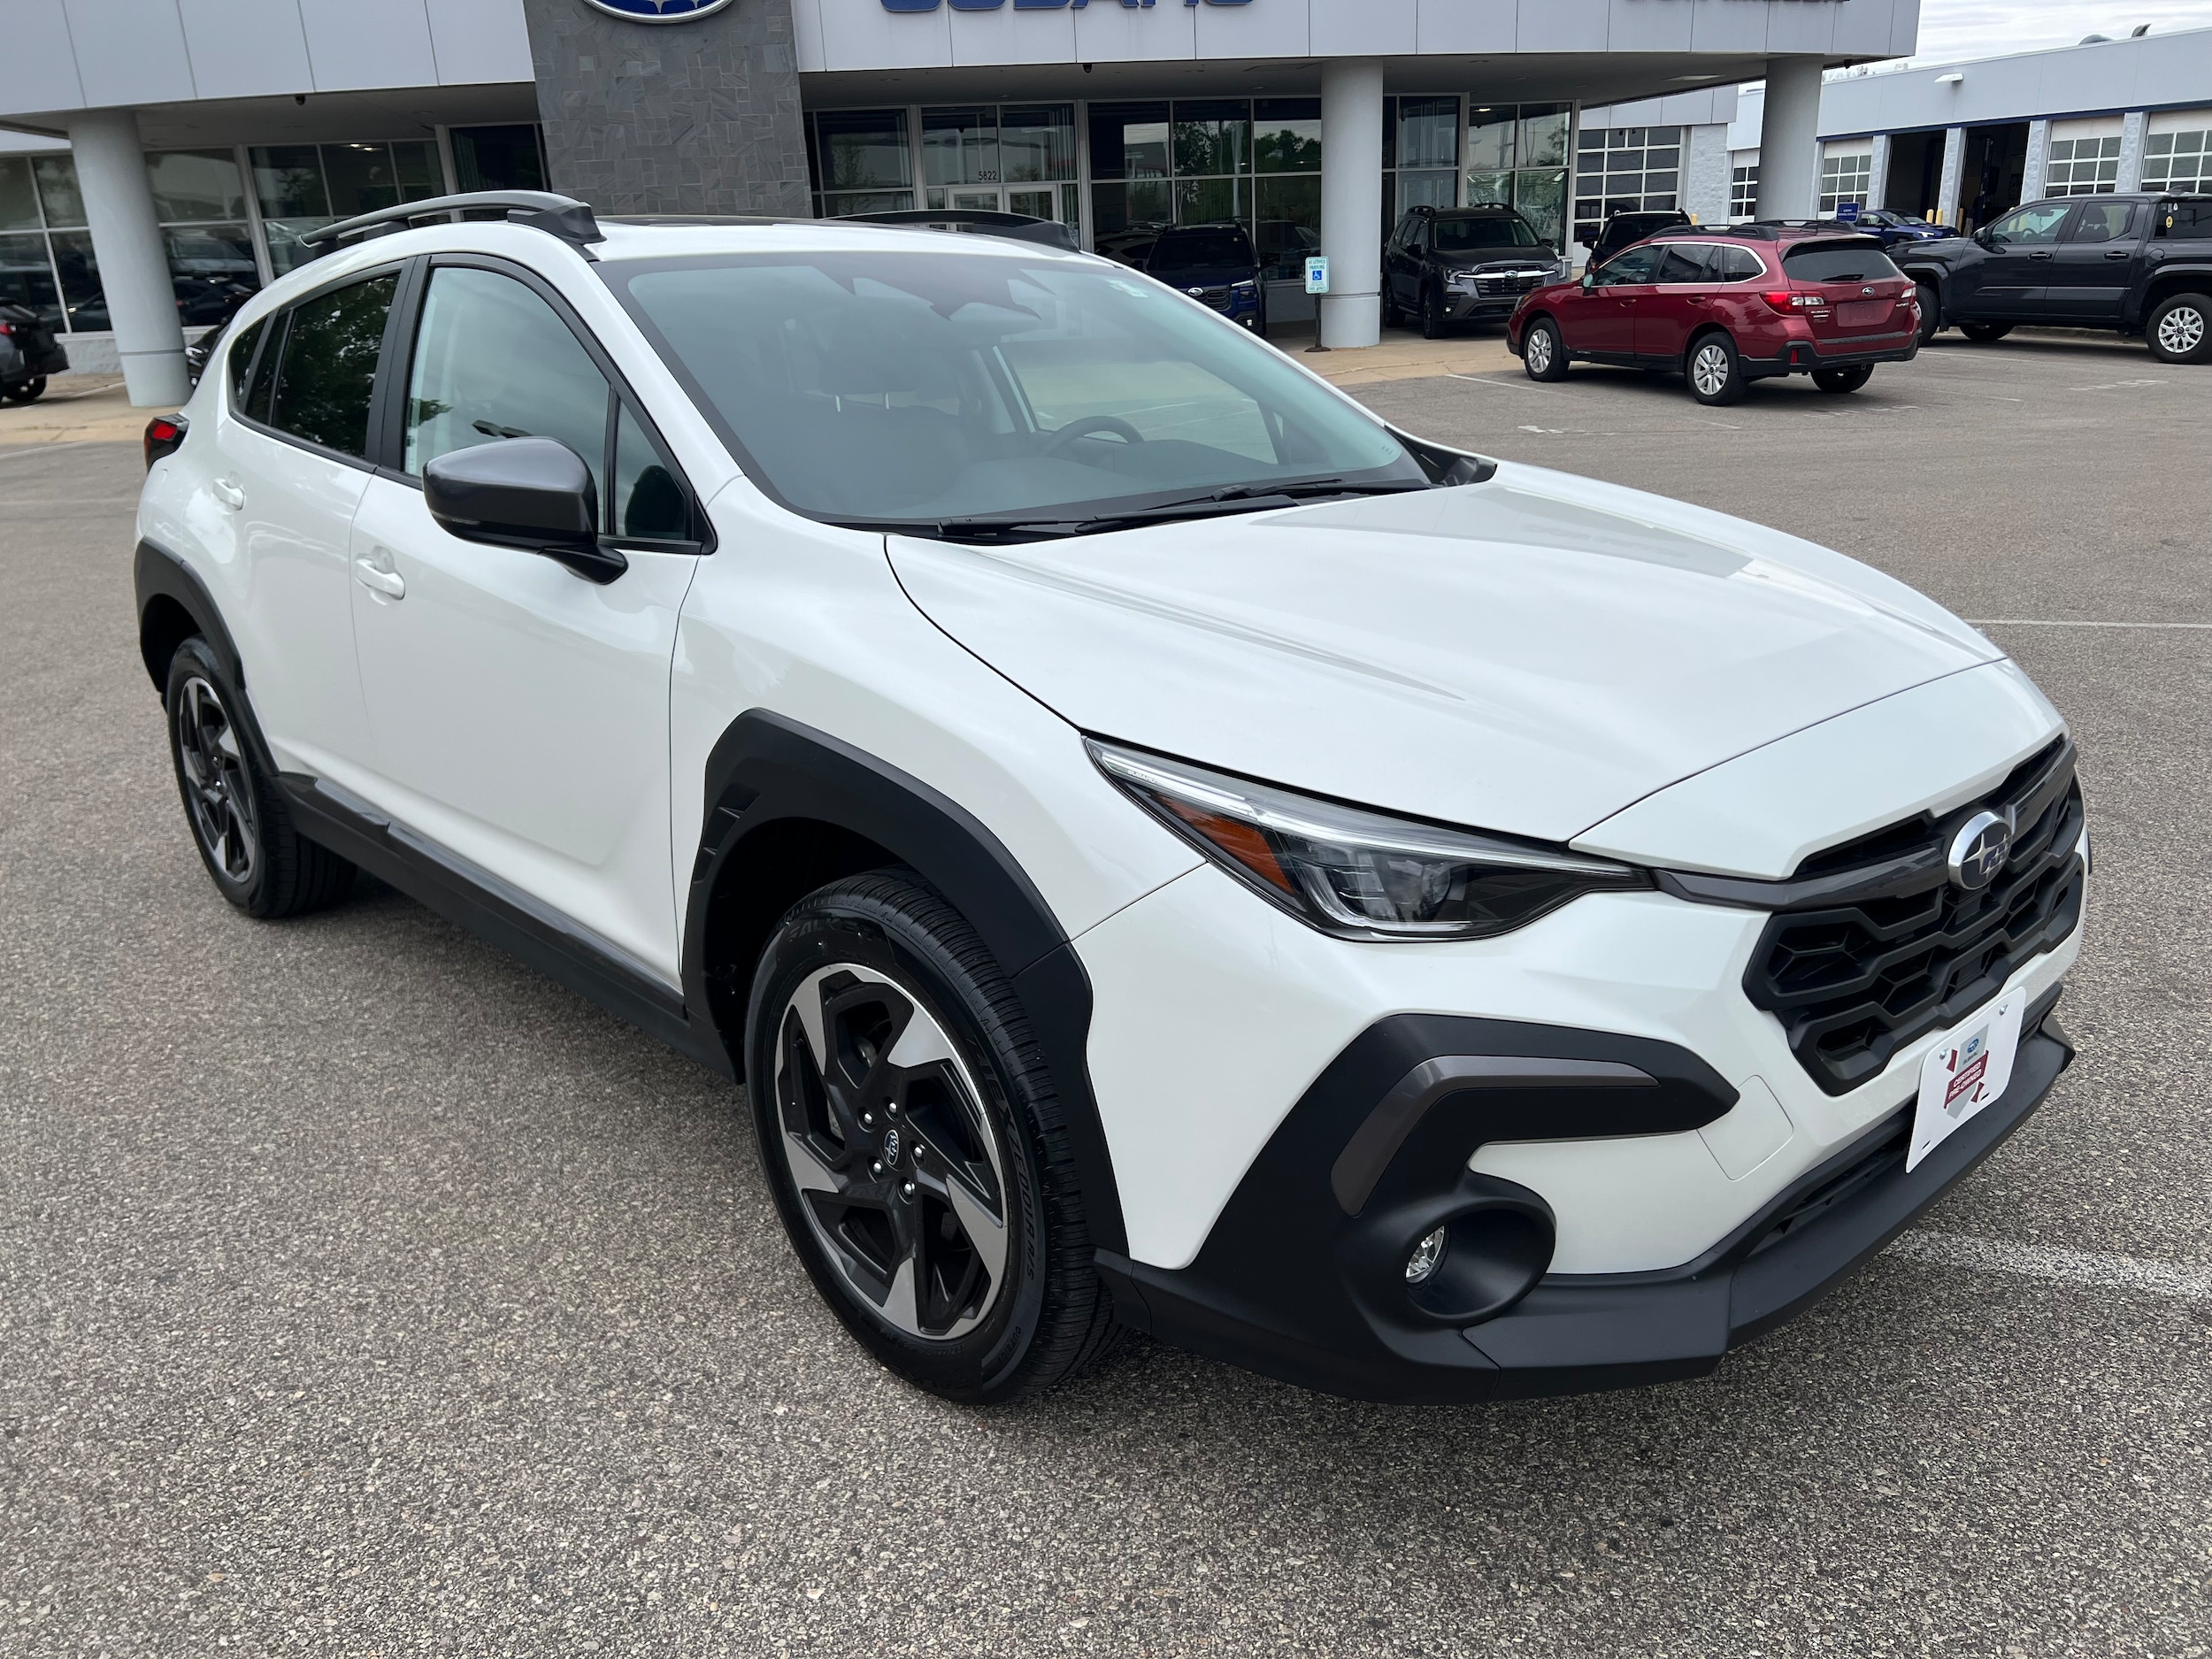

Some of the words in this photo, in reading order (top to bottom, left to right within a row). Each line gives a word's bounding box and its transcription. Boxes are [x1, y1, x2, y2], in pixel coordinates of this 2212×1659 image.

[978, 171, 997, 180] 5822
[1948, 1069, 1981, 1099] PRE-OWNED
[1954, 1062, 1981, 1087] CERTIFIED
